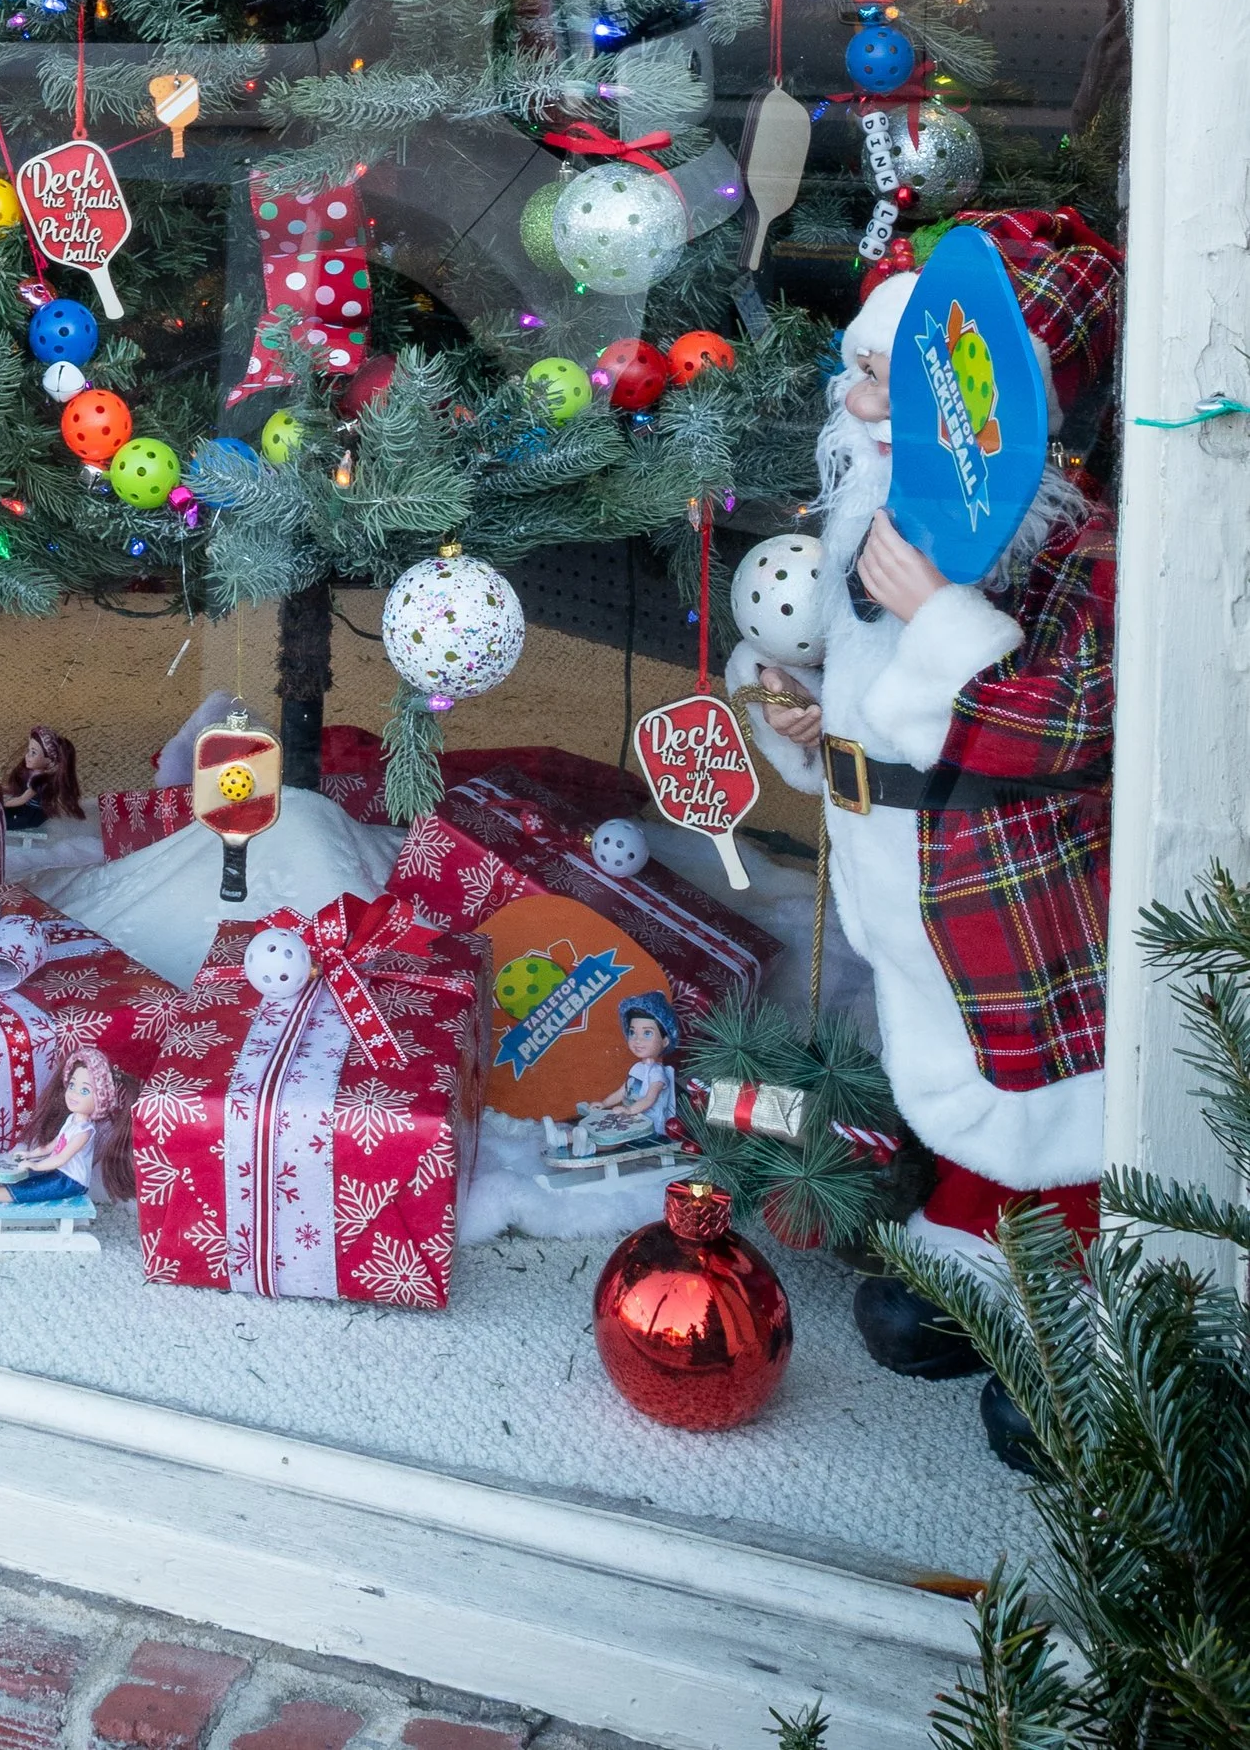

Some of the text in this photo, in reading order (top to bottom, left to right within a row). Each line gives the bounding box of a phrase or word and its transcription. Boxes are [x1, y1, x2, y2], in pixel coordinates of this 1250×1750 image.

[863, 116, 897, 188] DINK
[27, 153, 104, 198] Deck
[42, 189, 120, 211] the Halls
[39, 216, 104, 243] Pickle
[63, 242, 108, 263] balls
[925, 346, 977, 496] PICKLEBALL
[942, 359, 975, 446] TABLETOP
[645, 709, 729, 755] Deck
[661, 749, 748, 773] the Halls
[657, 775, 728, 807] Pickle
[683, 805, 733, 829] balls
[517, 969, 612, 1061] PICKLEBALL
[522, 976, 577, 1032] TABLETOP
